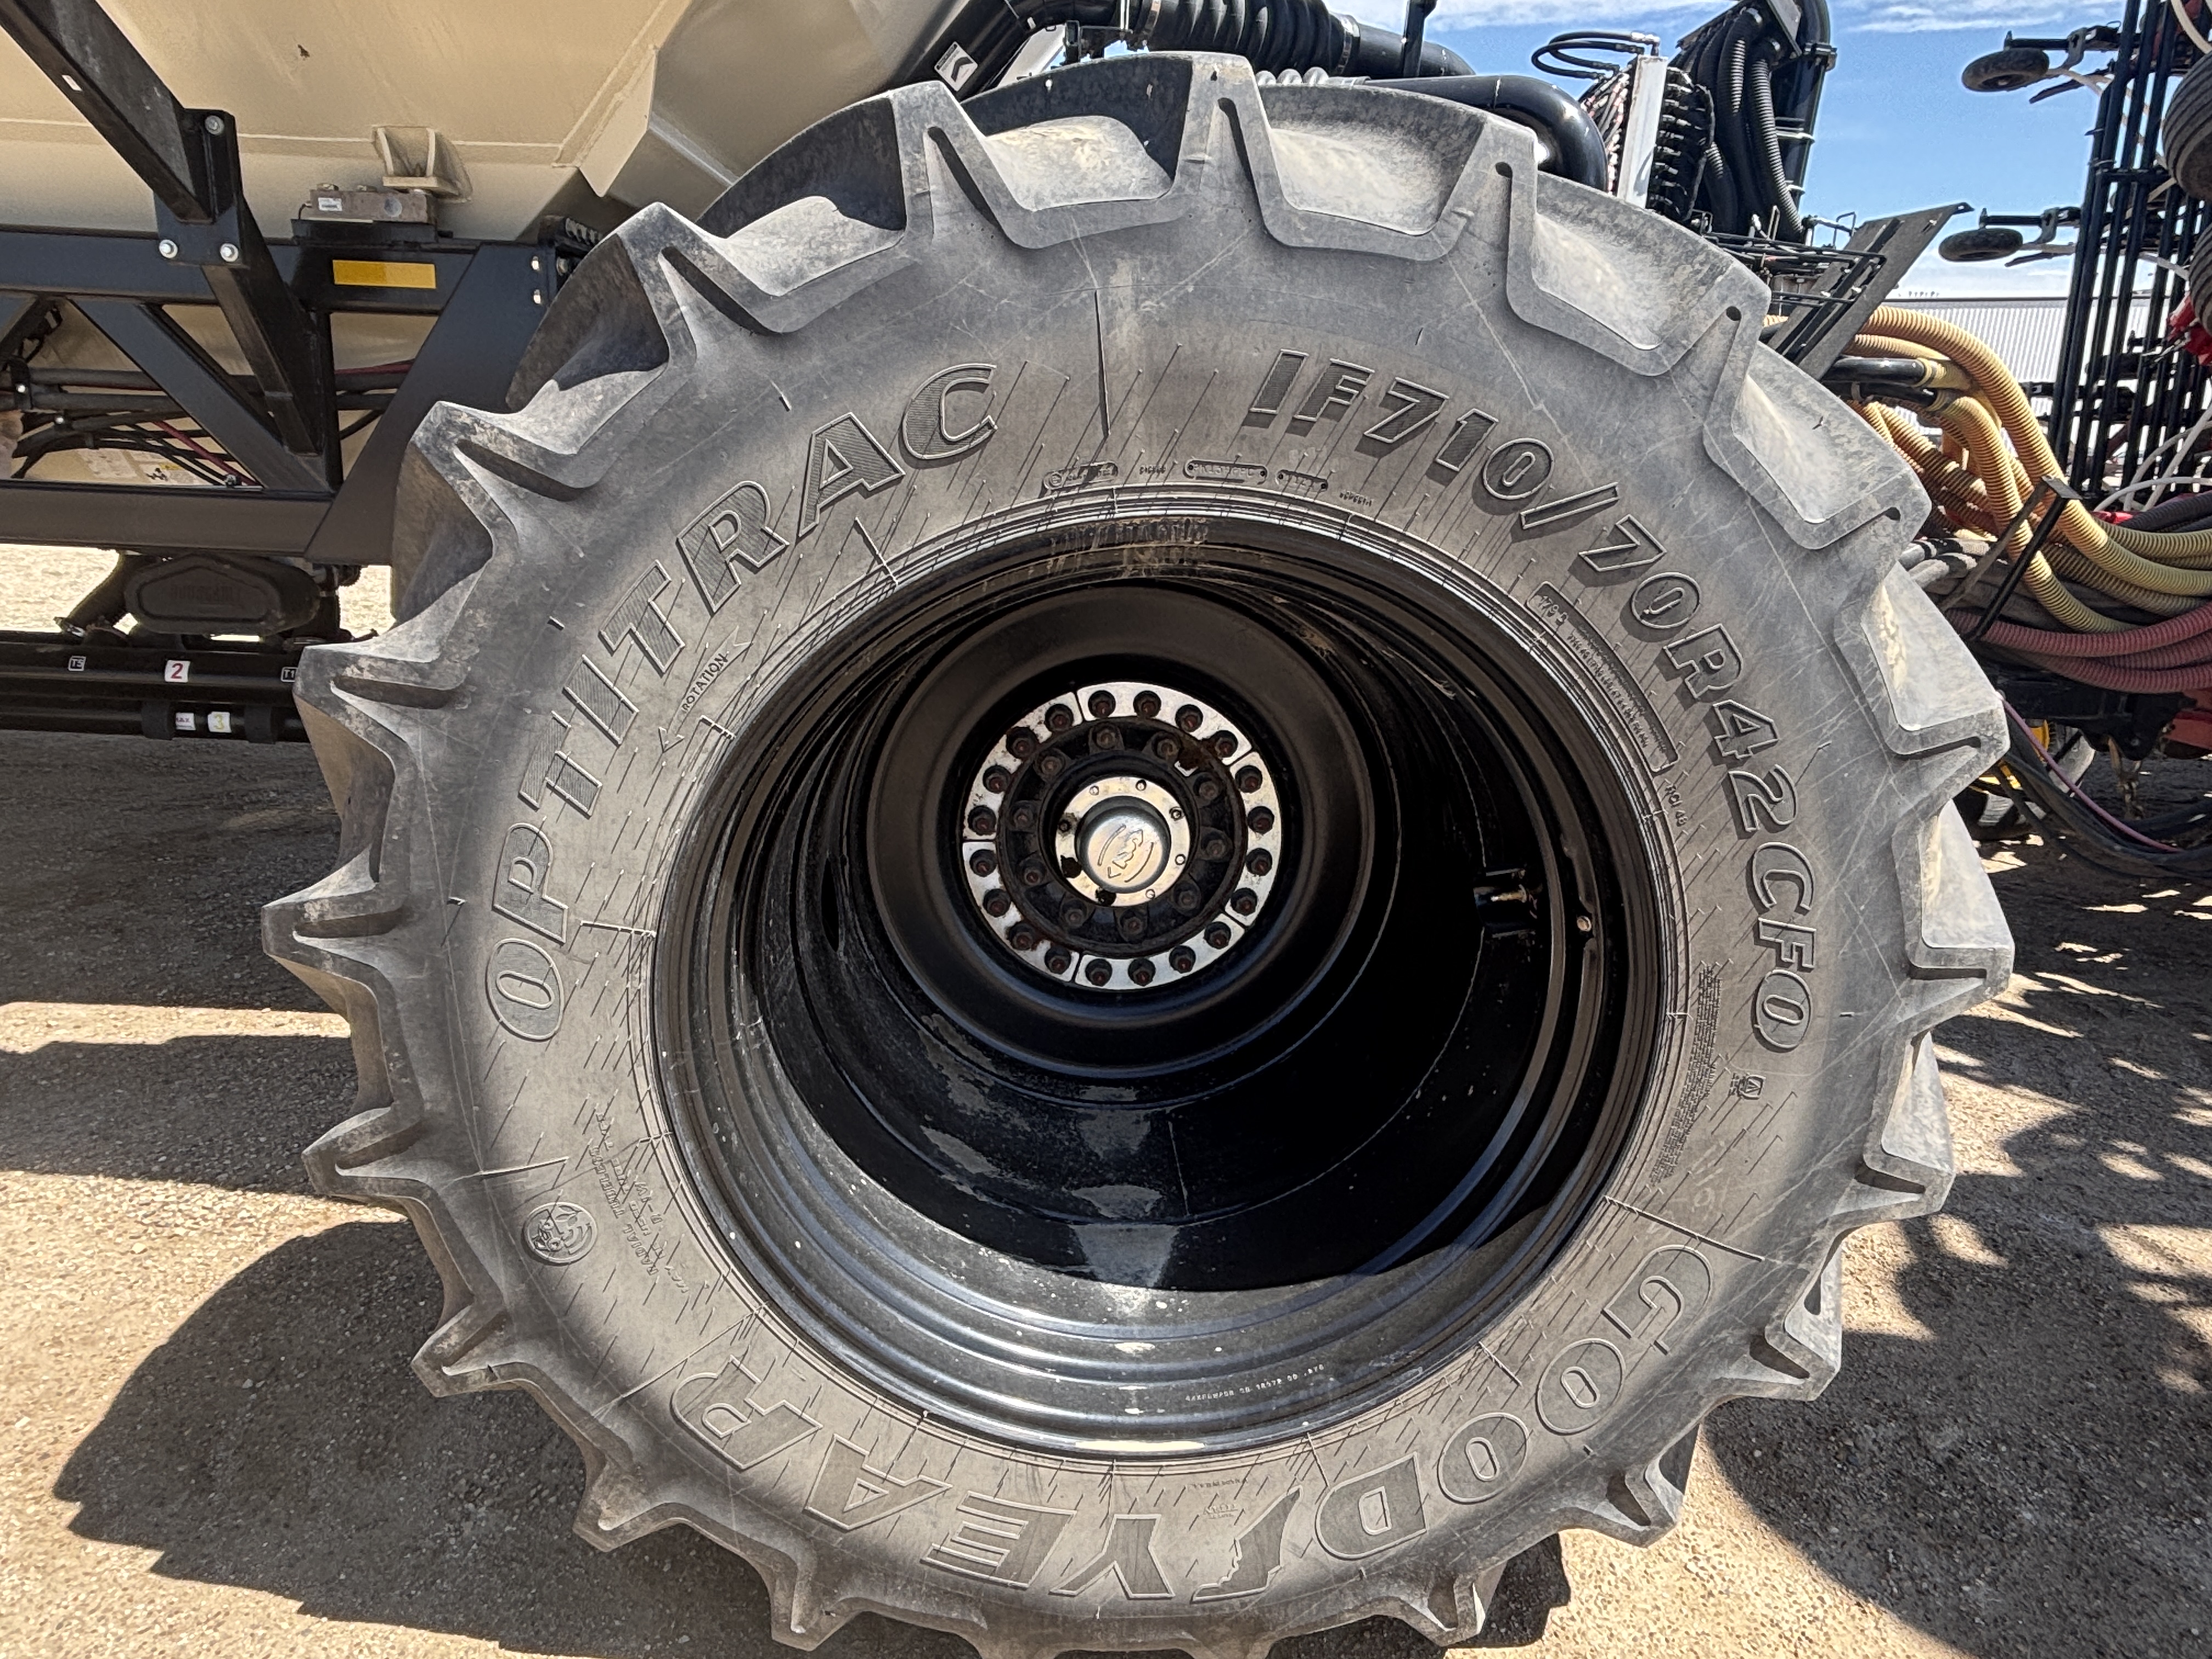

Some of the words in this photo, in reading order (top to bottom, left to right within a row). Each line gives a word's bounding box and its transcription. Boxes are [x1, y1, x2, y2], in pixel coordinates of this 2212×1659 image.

[170, 663, 183, 679] 2
[680, 652, 729, 712] ROTATION
[213, 714, 224, 730] 3
[486, 363, 997, 1041] OPTITRAC
[589, 1144, 625, 1218] TUBELESS
[622, 1223, 658, 1276] RADIAL
[668, 1244, 1713, 1601] GOODYEAR
